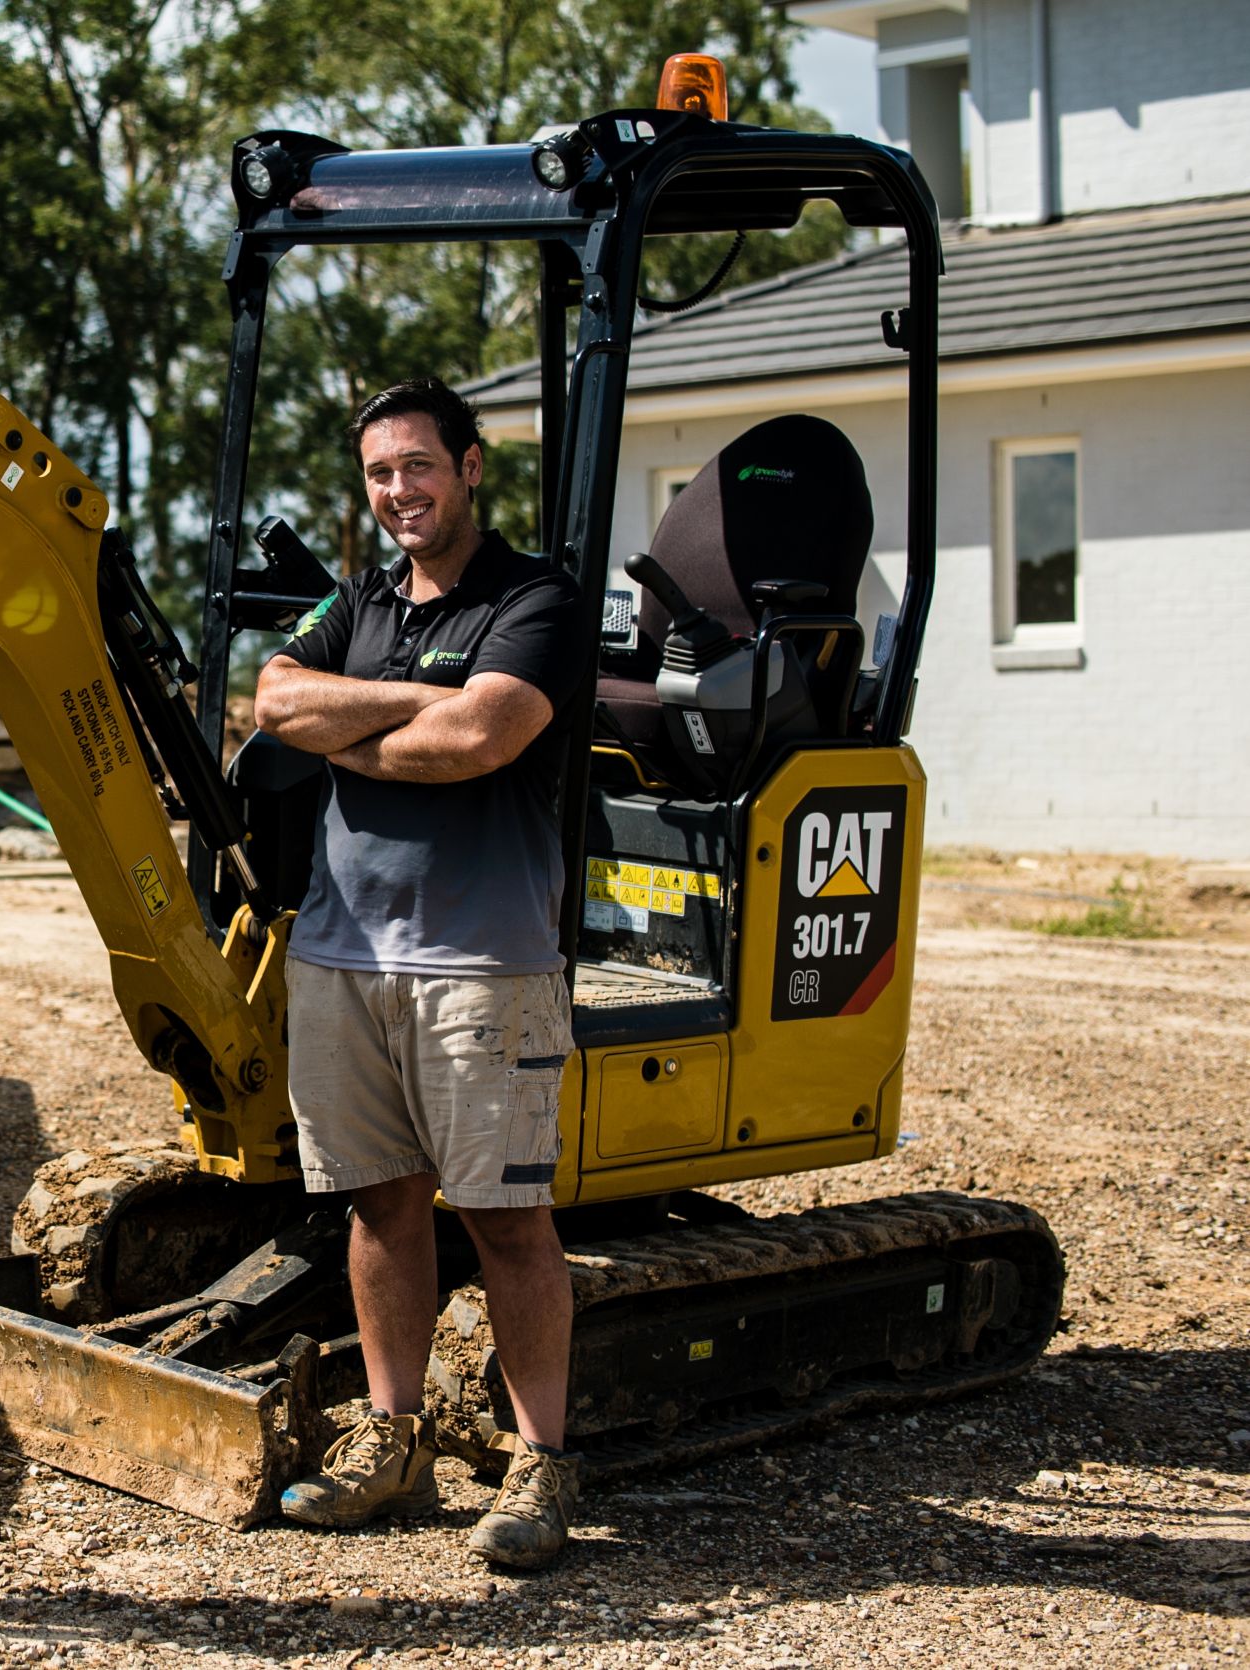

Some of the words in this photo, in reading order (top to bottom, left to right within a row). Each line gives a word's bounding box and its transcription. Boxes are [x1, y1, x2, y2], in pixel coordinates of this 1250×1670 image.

[60, 689, 77, 715] PICK
[69, 714, 85, 736] AND
[77, 736, 98, 769] CARRY
[90, 769, 102, 782] 80
[77, 688, 108, 747] STATIONARY
[99, 747, 112, 760] 95
[91, 680, 111, 712] QUICK
[103, 711, 121, 740] HITCH
[114, 740, 132, 767] ONLY
[797, 811, 892, 898] CAT
[792, 912, 871, 959] 301.7
[788, 969, 820, 1005] CR
